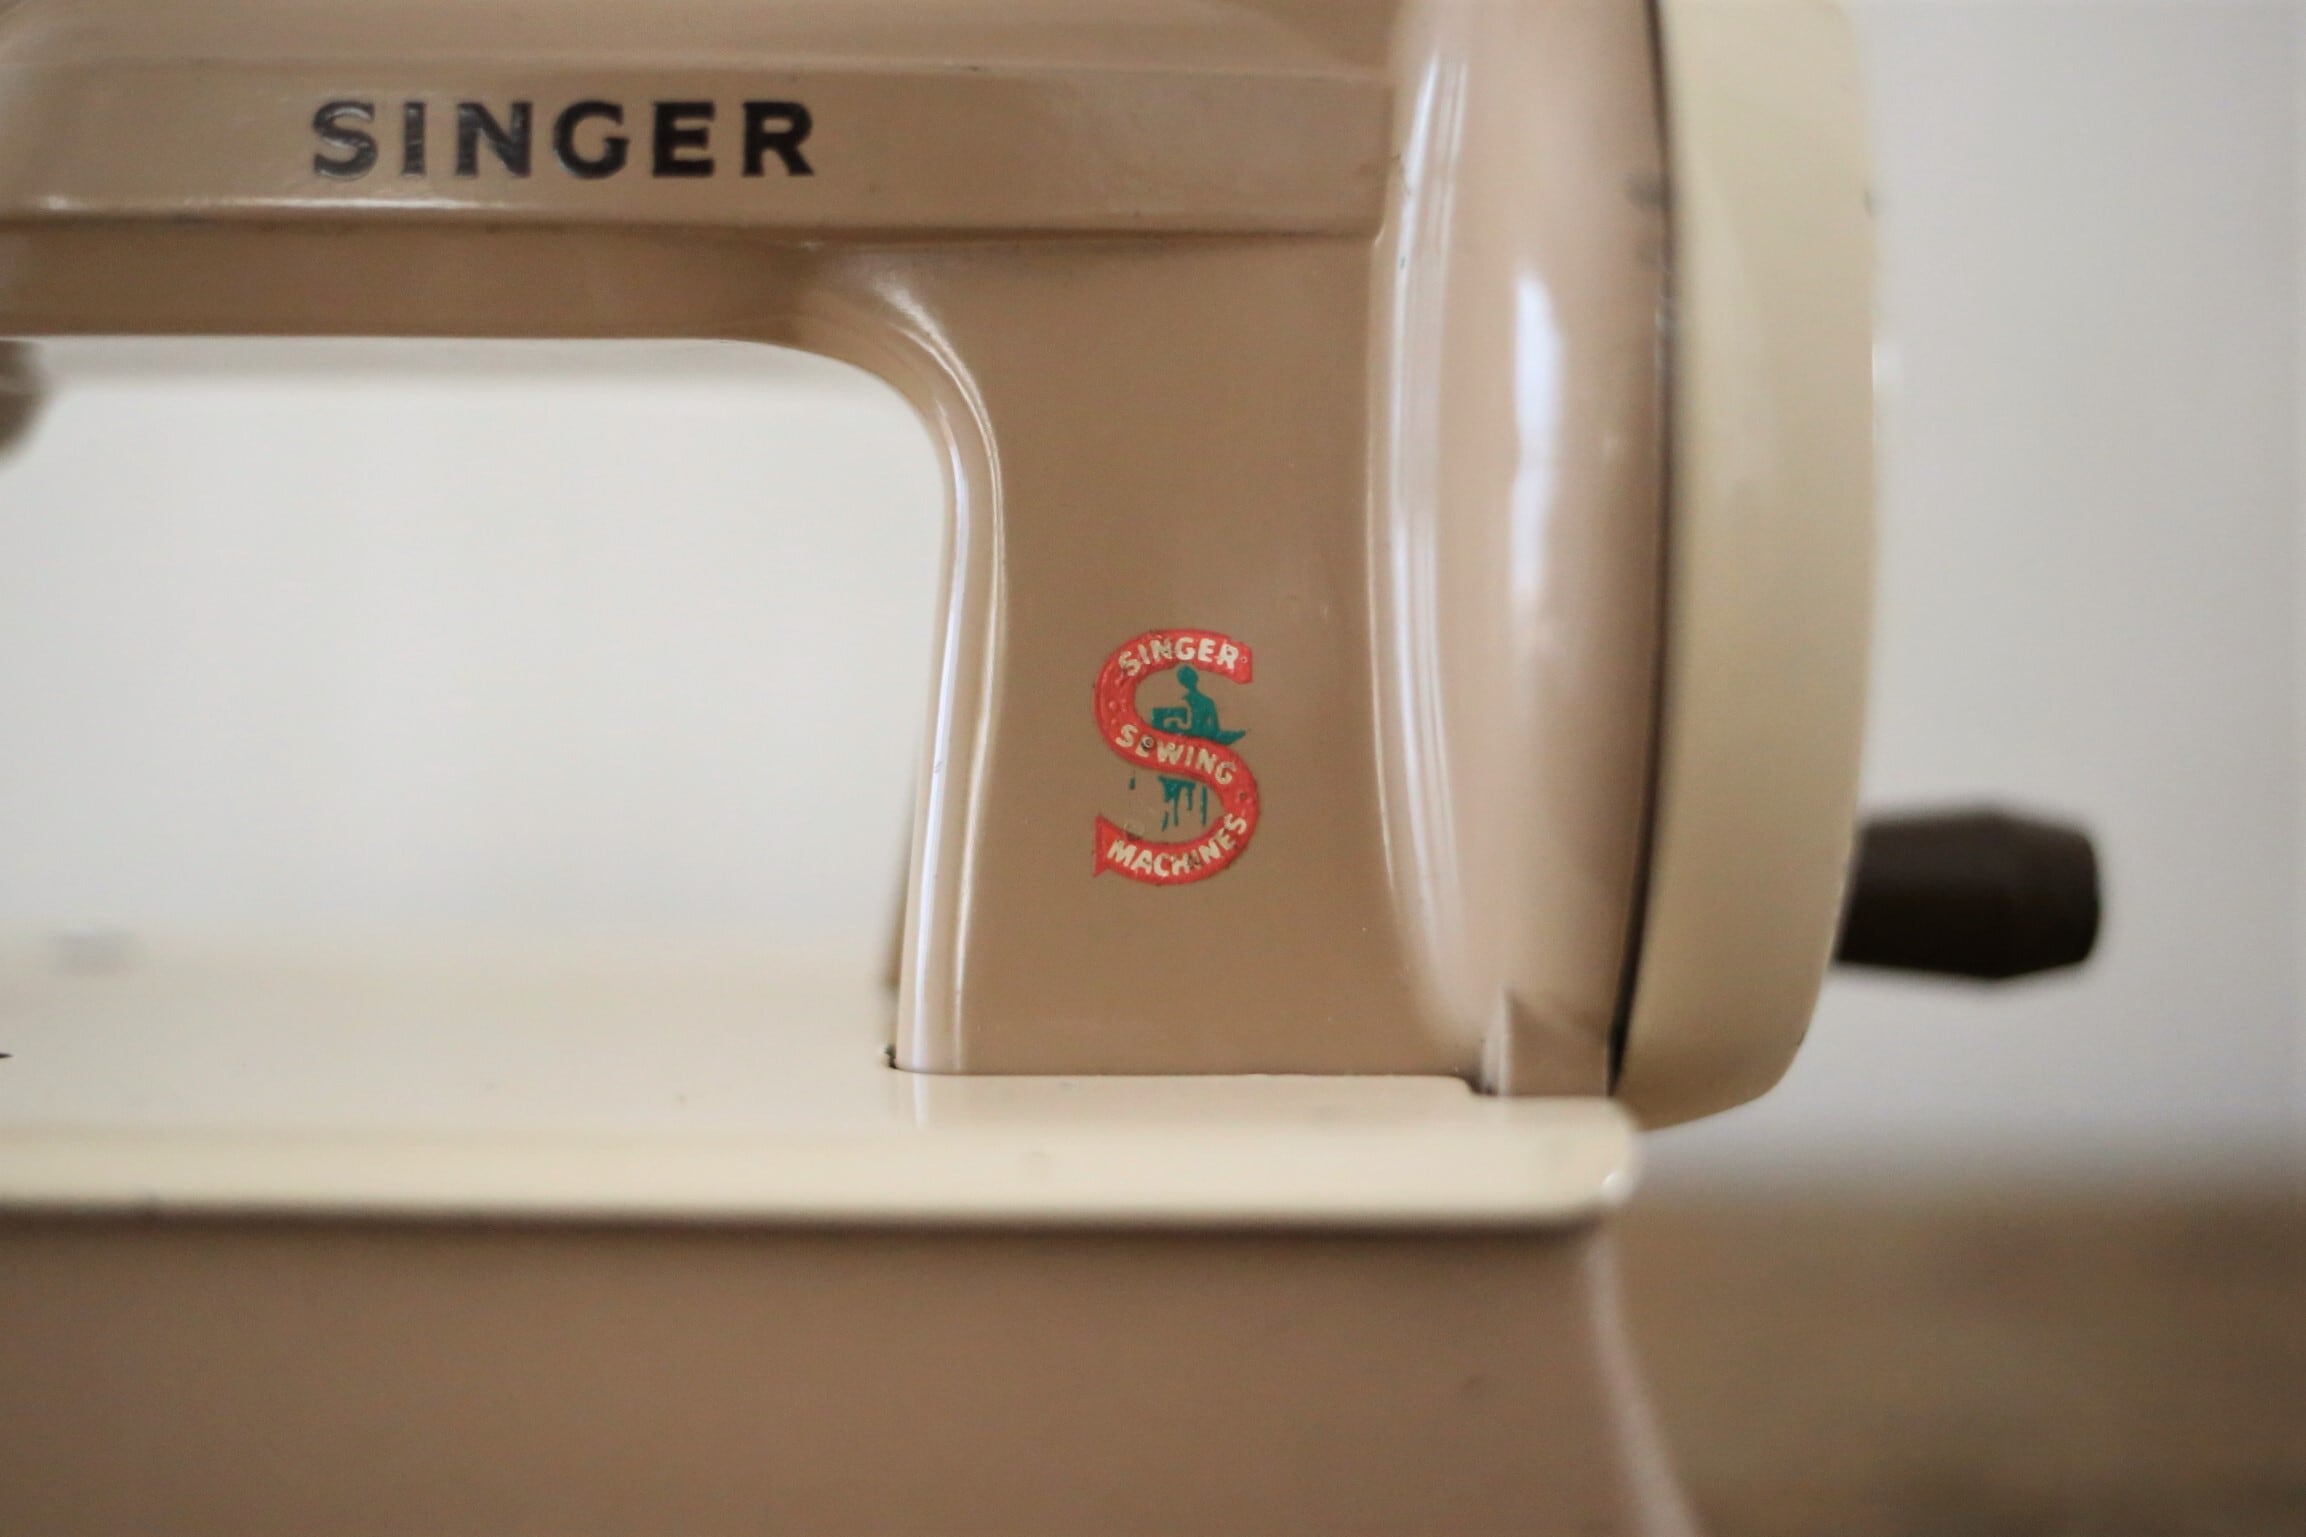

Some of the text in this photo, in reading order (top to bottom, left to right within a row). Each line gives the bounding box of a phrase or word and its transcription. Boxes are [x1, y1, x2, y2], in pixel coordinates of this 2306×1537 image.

[312, 99, 814, 179] SINGER
[1118, 637, 1240, 677] SINGER
[1115, 724, 1238, 785] SEWING
[1106, 813, 1248, 878] MACHINES
